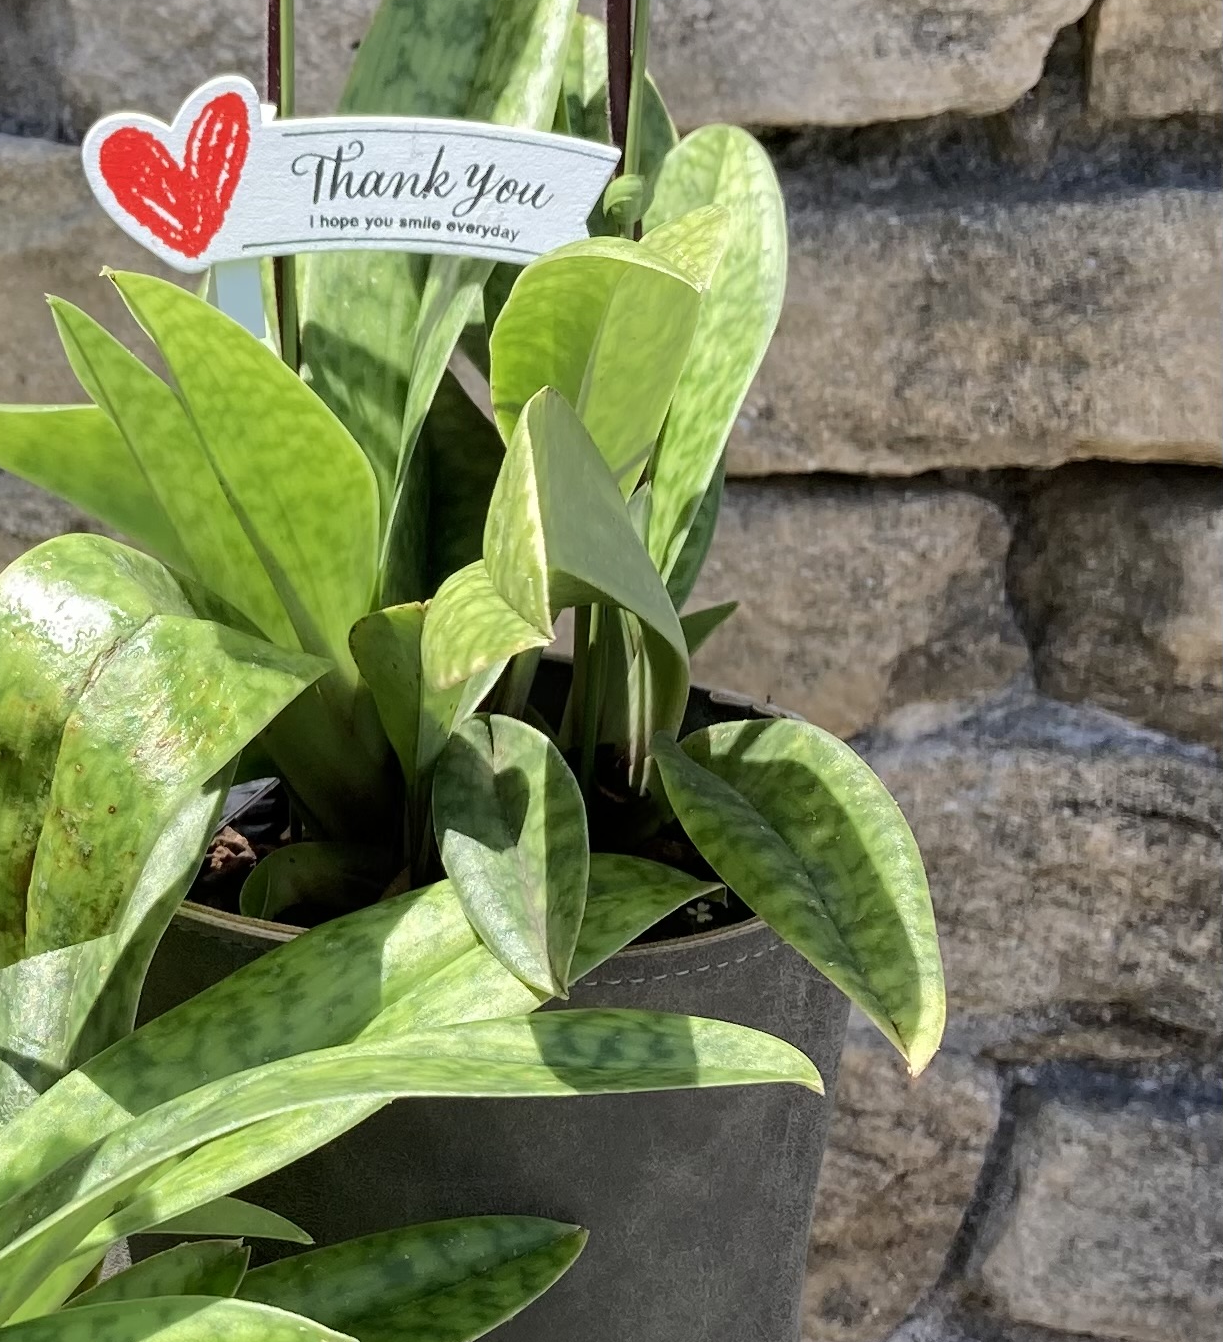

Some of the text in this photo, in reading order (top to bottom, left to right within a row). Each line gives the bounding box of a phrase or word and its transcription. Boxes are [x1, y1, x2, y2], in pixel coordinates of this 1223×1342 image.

[291, 139, 555, 217] Thank You
[309, 215, 520, 243] I hope you smile everyday
